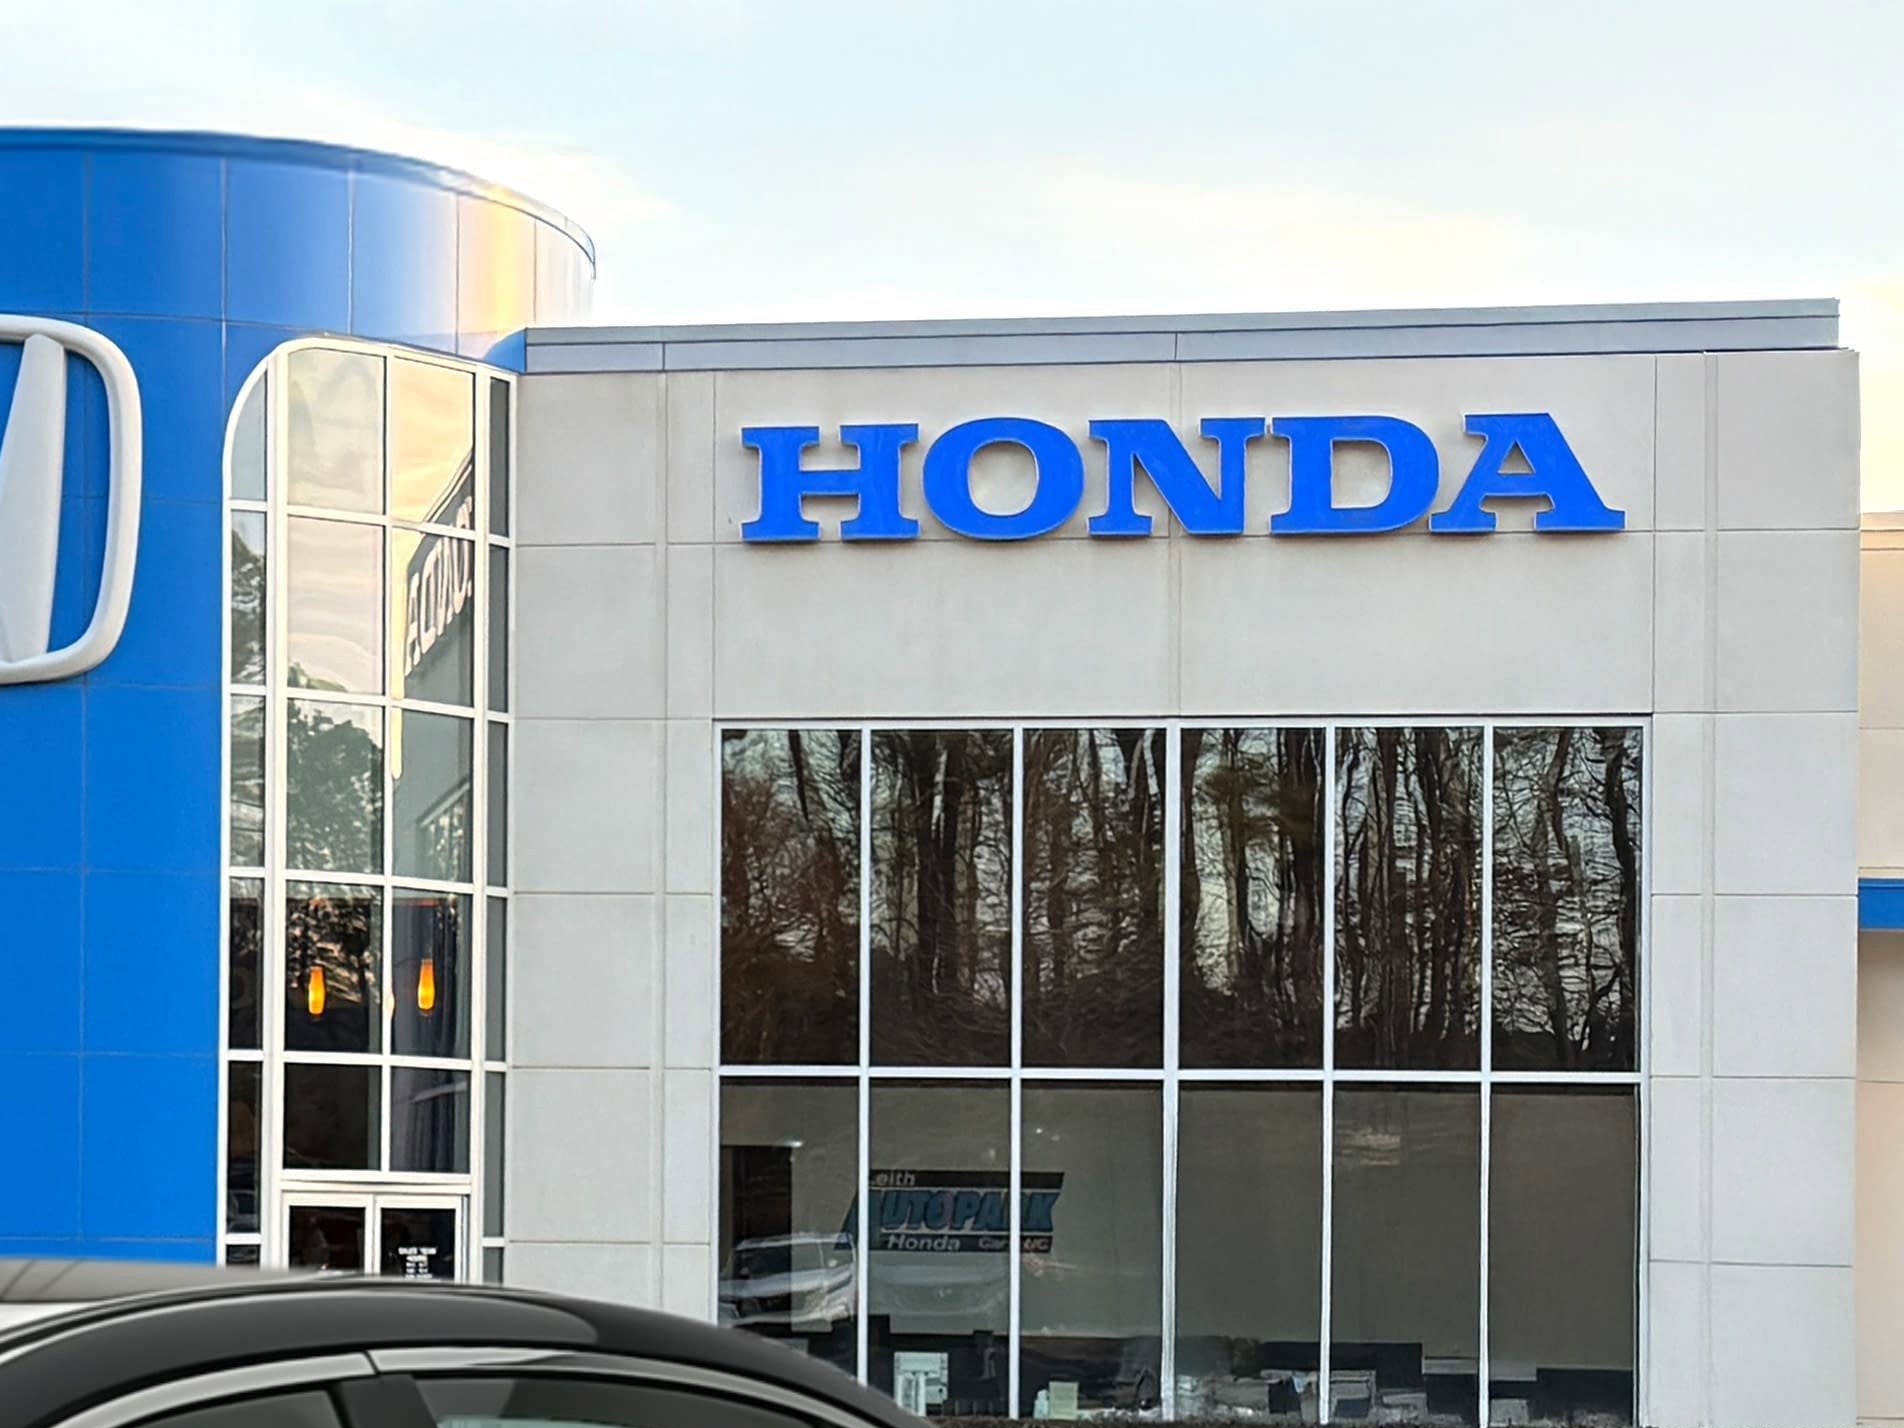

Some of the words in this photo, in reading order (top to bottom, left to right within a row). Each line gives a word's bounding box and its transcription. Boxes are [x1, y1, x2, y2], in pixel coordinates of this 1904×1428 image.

[741, 412, 1625, 542] HONDA
[871, 1171, 916, 1187] eith
[887, 1235, 961, 1251] Honda
